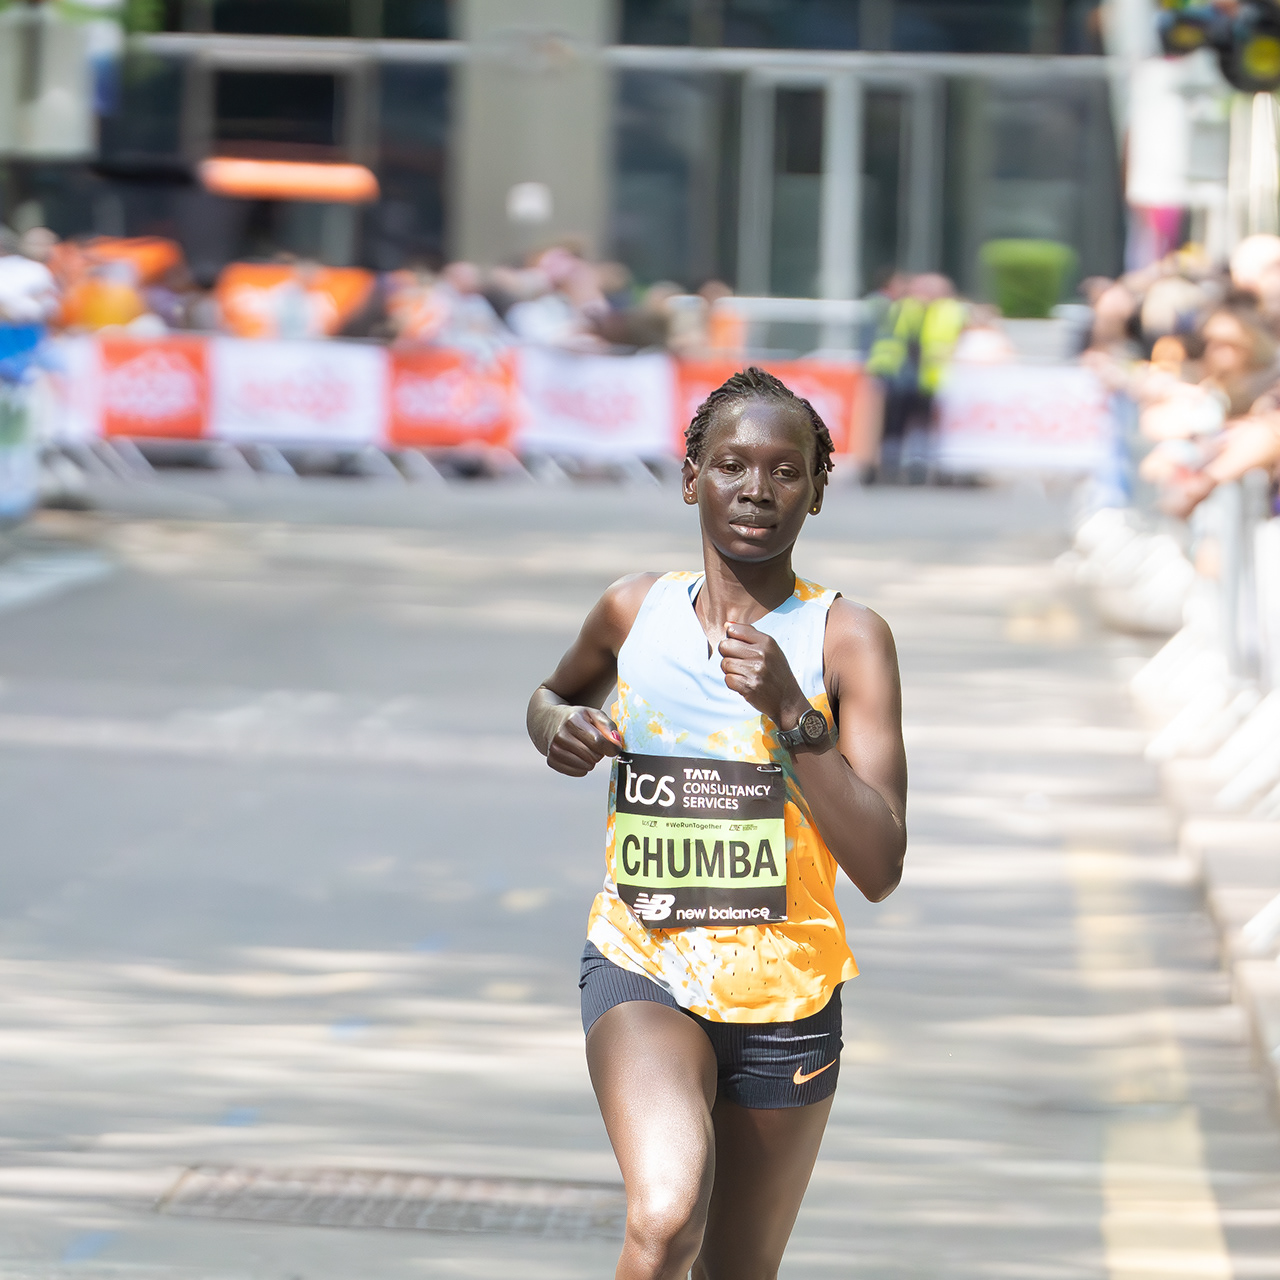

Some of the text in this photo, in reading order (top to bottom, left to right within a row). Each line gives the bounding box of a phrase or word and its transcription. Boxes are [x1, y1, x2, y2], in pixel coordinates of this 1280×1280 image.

[683, 768, 721, 781] TATA
[625, 764, 676, 807] tcs
[683, 782, 771, 797] CONSULTANCY
[683, 796, 739, 810] SERVICES
[665, 821, 722, 831] #WeRunTogether
[621, 834, 779, 879] CHUMBA
[676, 905, 770, 920] new balance
